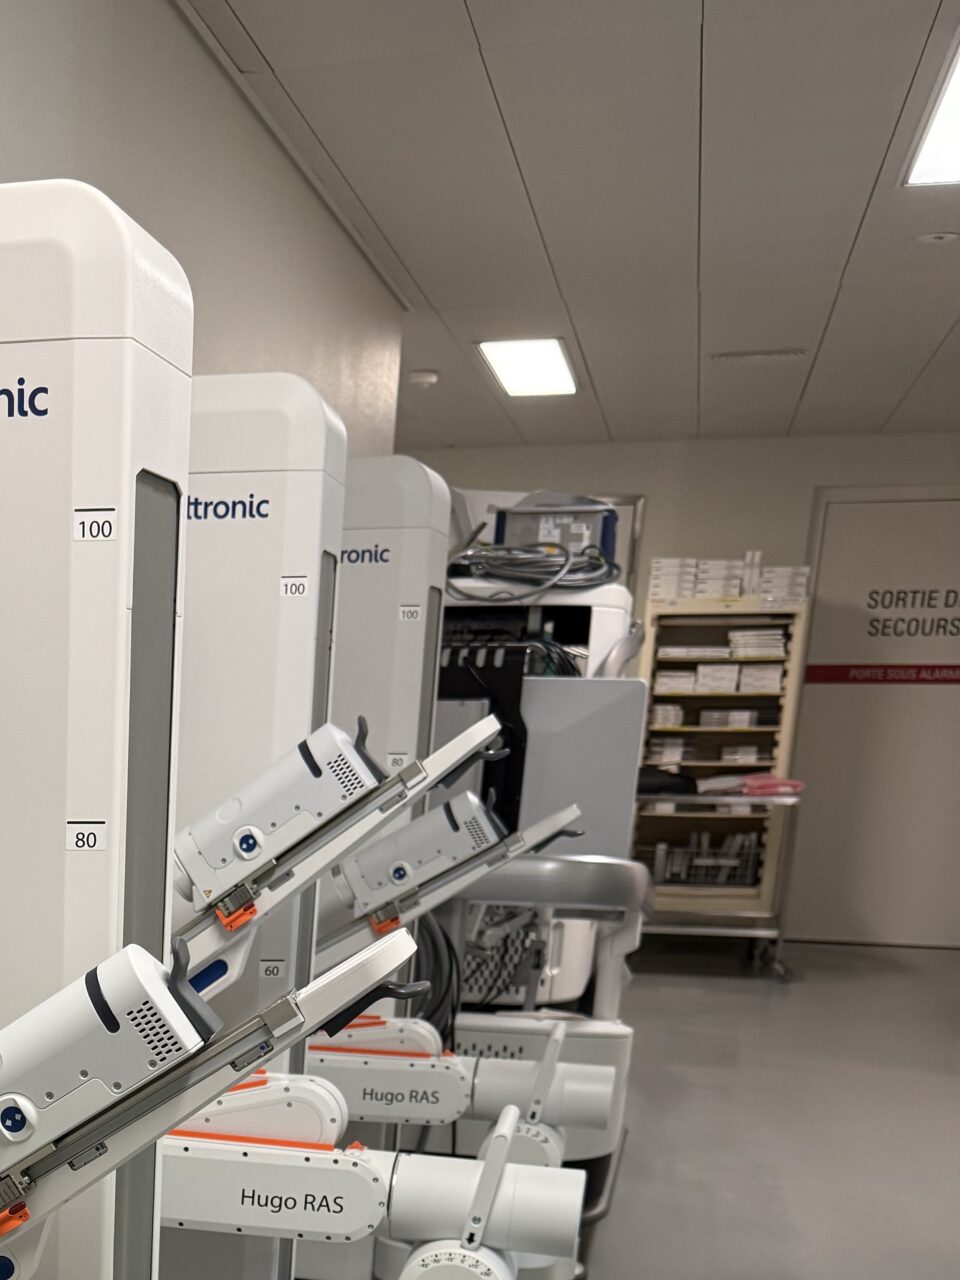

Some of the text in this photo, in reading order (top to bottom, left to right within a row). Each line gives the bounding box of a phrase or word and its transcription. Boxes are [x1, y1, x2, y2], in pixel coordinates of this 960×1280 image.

[78, 520, 113, 538] 100
[340, 544, 390, 564] ronic
[283, 583, 306, 595] 100
[867, 590, 960, 609] SORTIE D
[401, 610, 419, 620] 100
[867, 618, 960, 637] SECOURS
[848, 667, 884, 680] PORTE
[391, 758, 404, 768] 80
[75, 832, 97, 848] 80
[264, 966, 279, 976] 60
[362, 1087, 440, 1106] Hugo RAS
[241, 1188, 344, 1214] Hugo RAS
